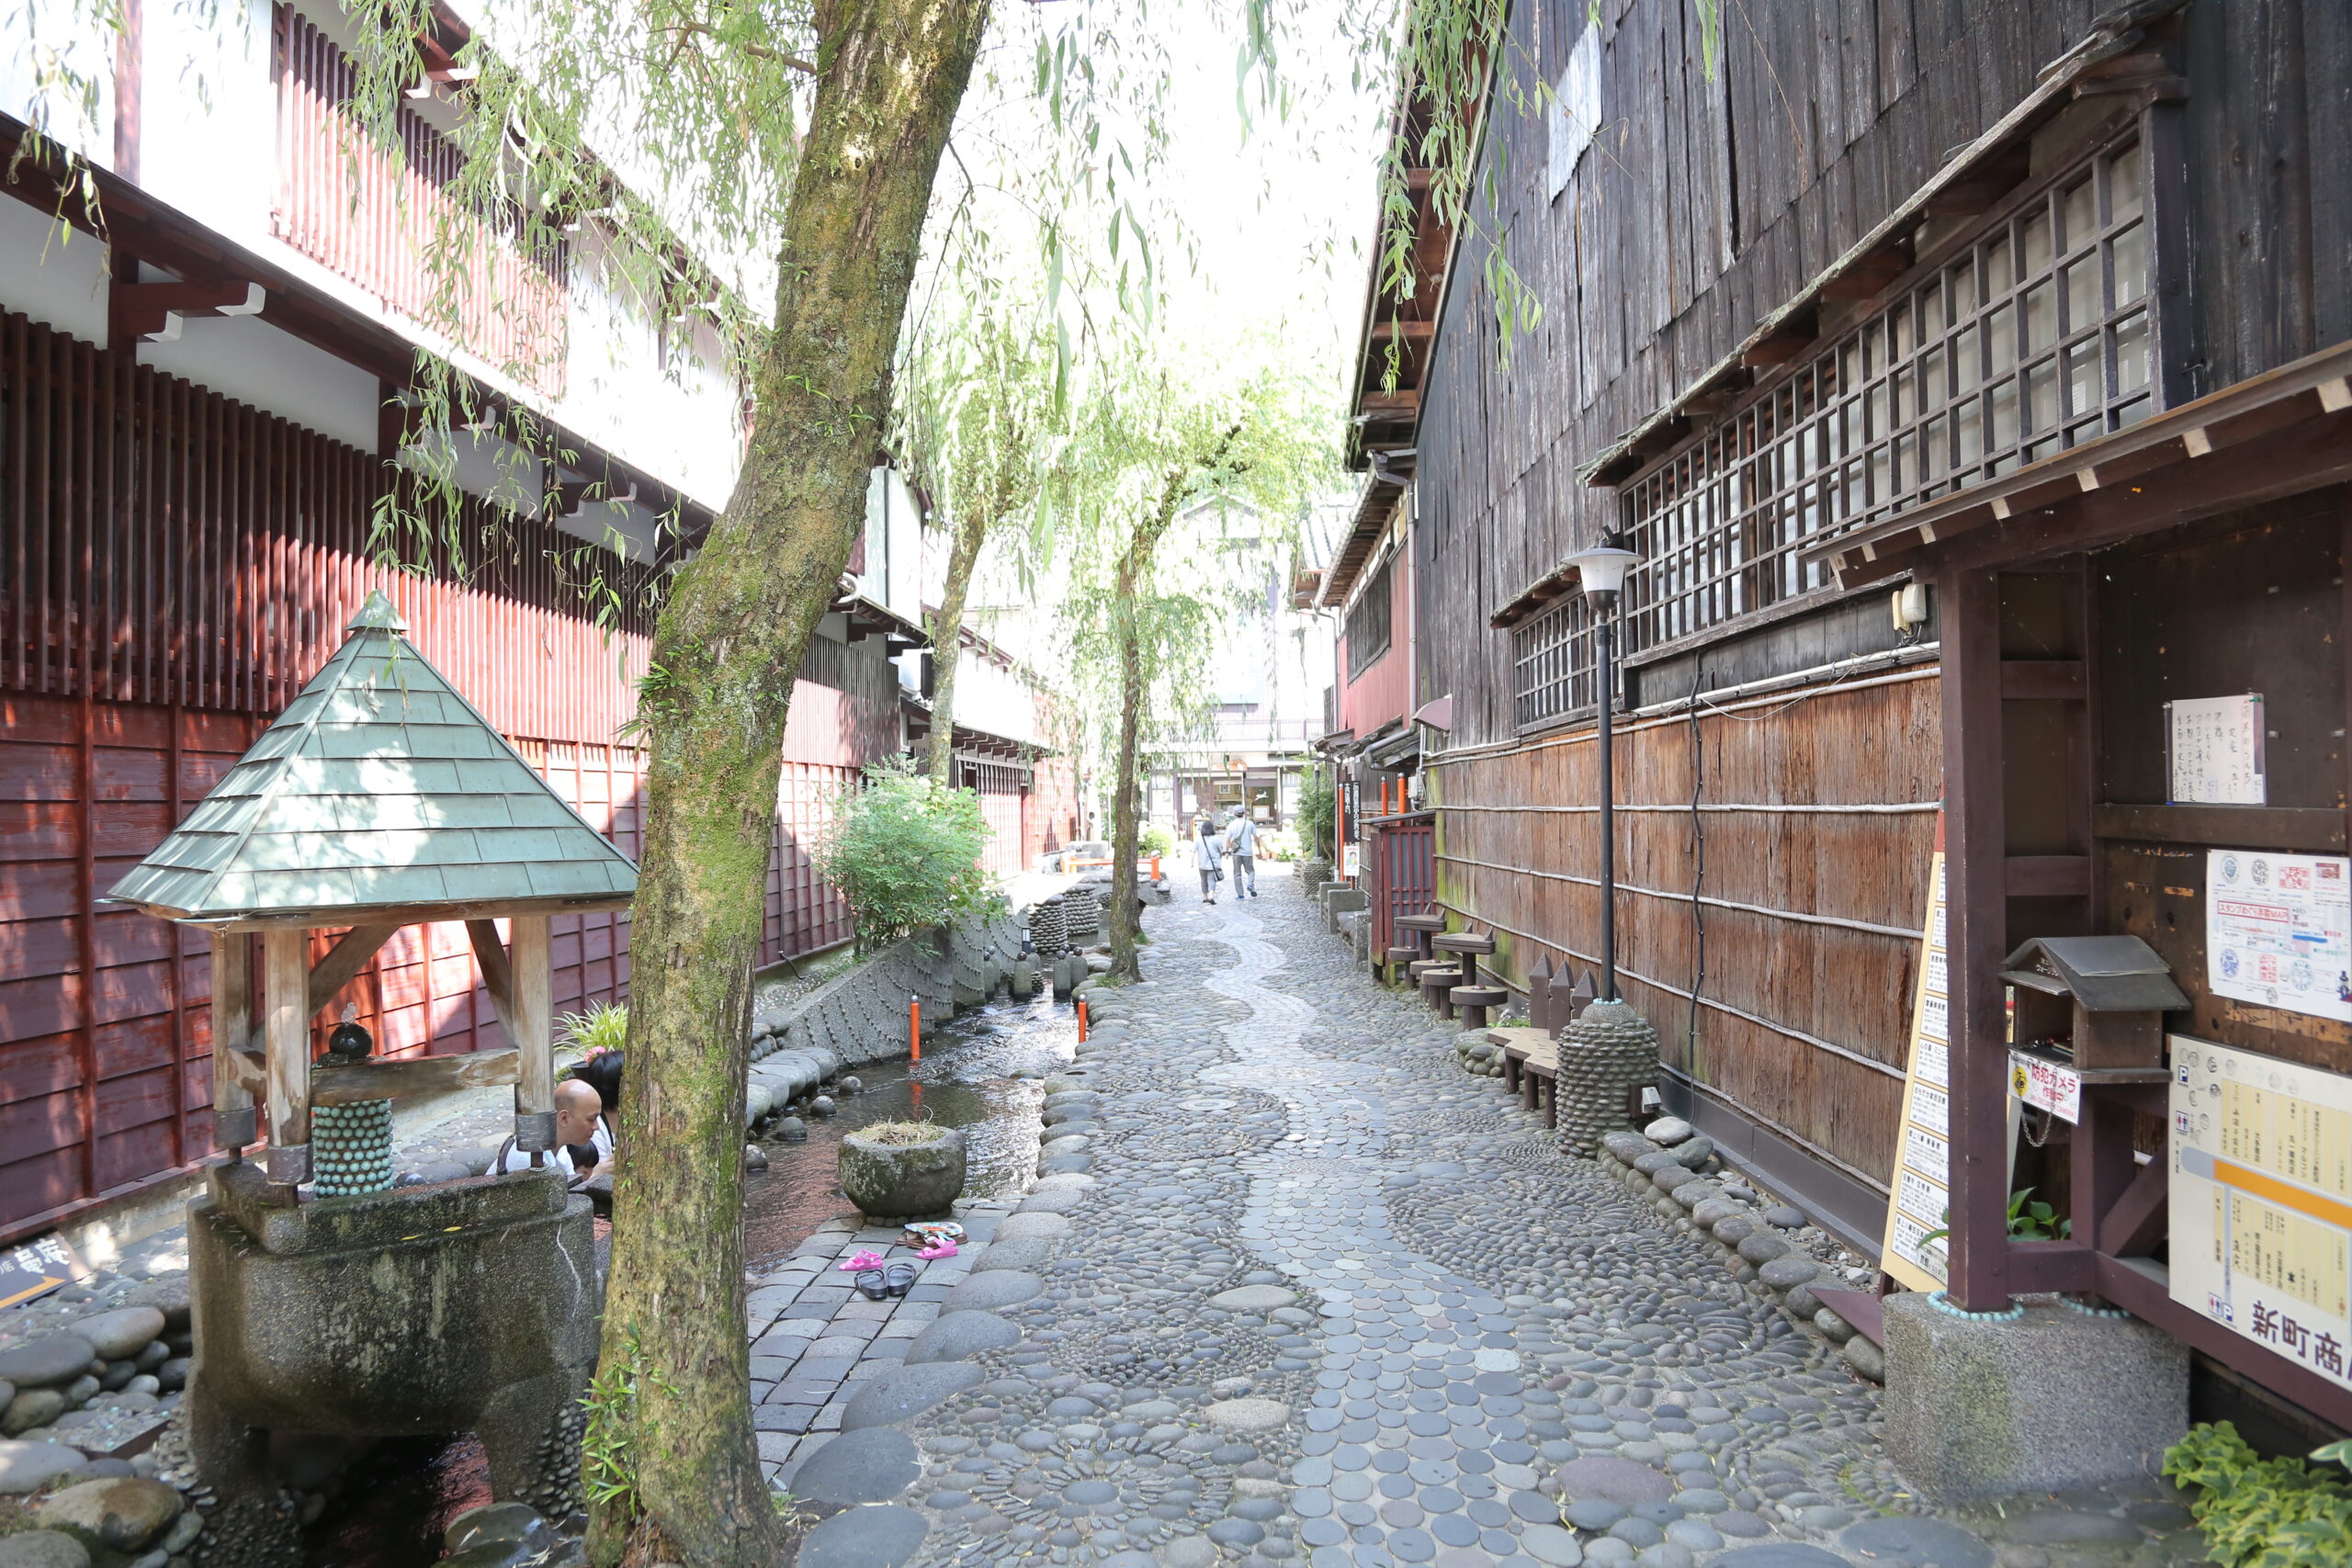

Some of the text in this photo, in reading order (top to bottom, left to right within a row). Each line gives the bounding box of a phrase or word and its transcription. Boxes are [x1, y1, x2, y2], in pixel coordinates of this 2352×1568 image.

[2030, 1064, 2076, 1094] 防犯カメラ
[2042, 1086, 2064, 1102] 作動中
[2251, 1298, 2352, 1382] 新町商
